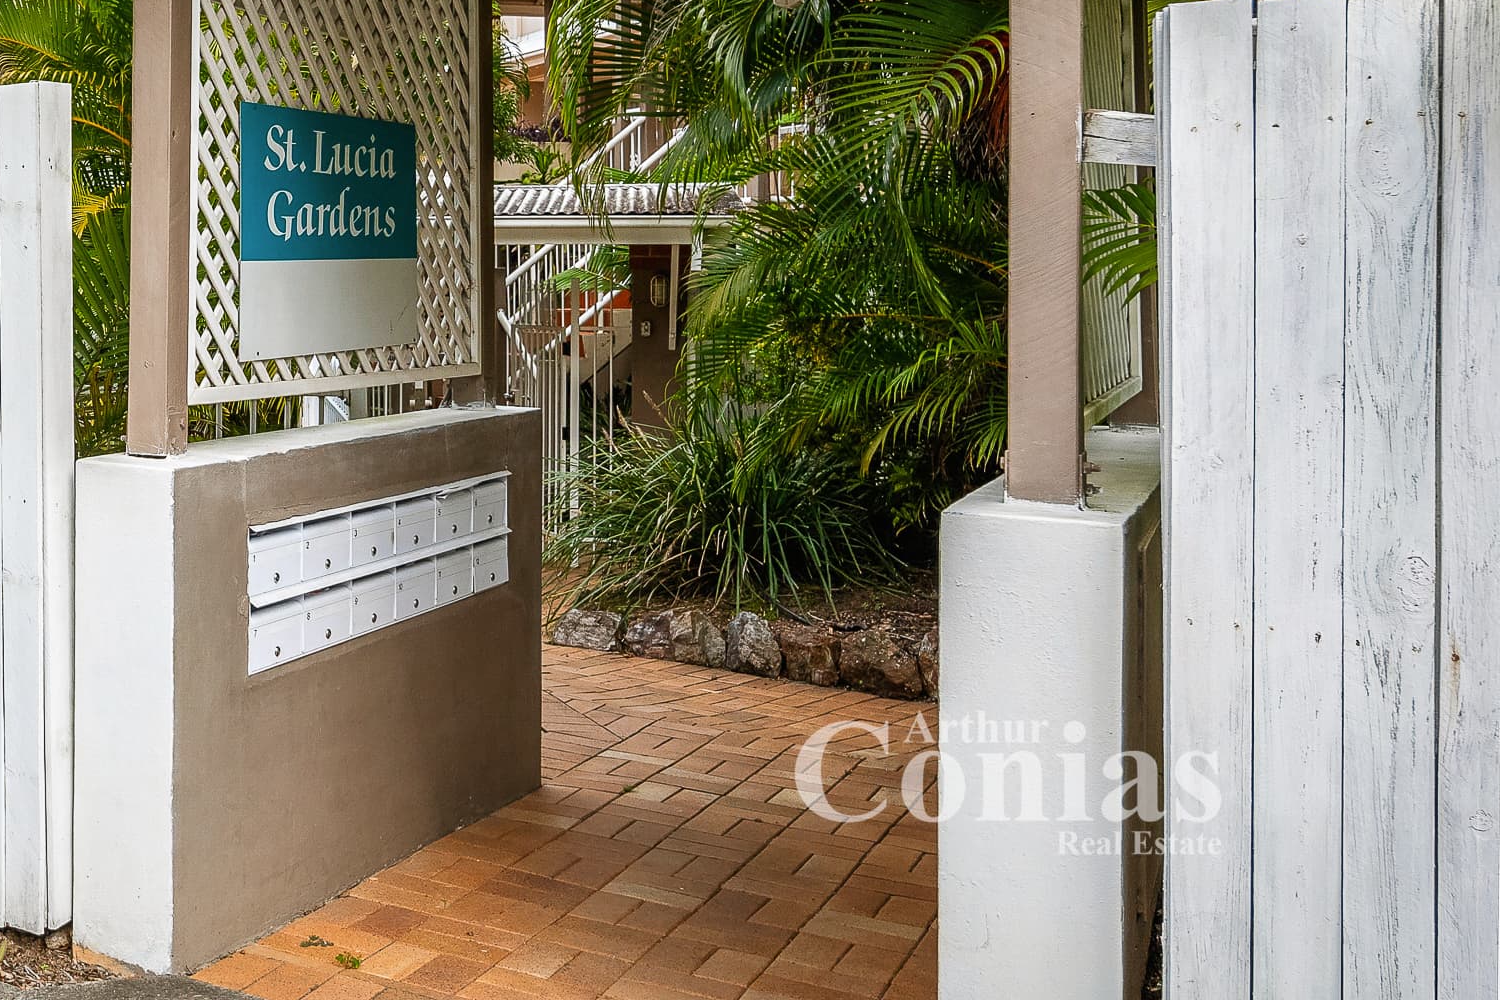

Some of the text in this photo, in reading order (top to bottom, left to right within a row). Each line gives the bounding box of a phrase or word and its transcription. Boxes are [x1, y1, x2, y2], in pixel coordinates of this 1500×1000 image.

[263, 124, 397, 179] St. Lucia
[267, 187, 396, 243] Gardens
[353, 529, 358, 538] 3
[306, 541, 310, 550] 2
[353, 597, 359, 606] 9
[306, 612, 311, 621] 8
[253, 629, 258, 638] 7
